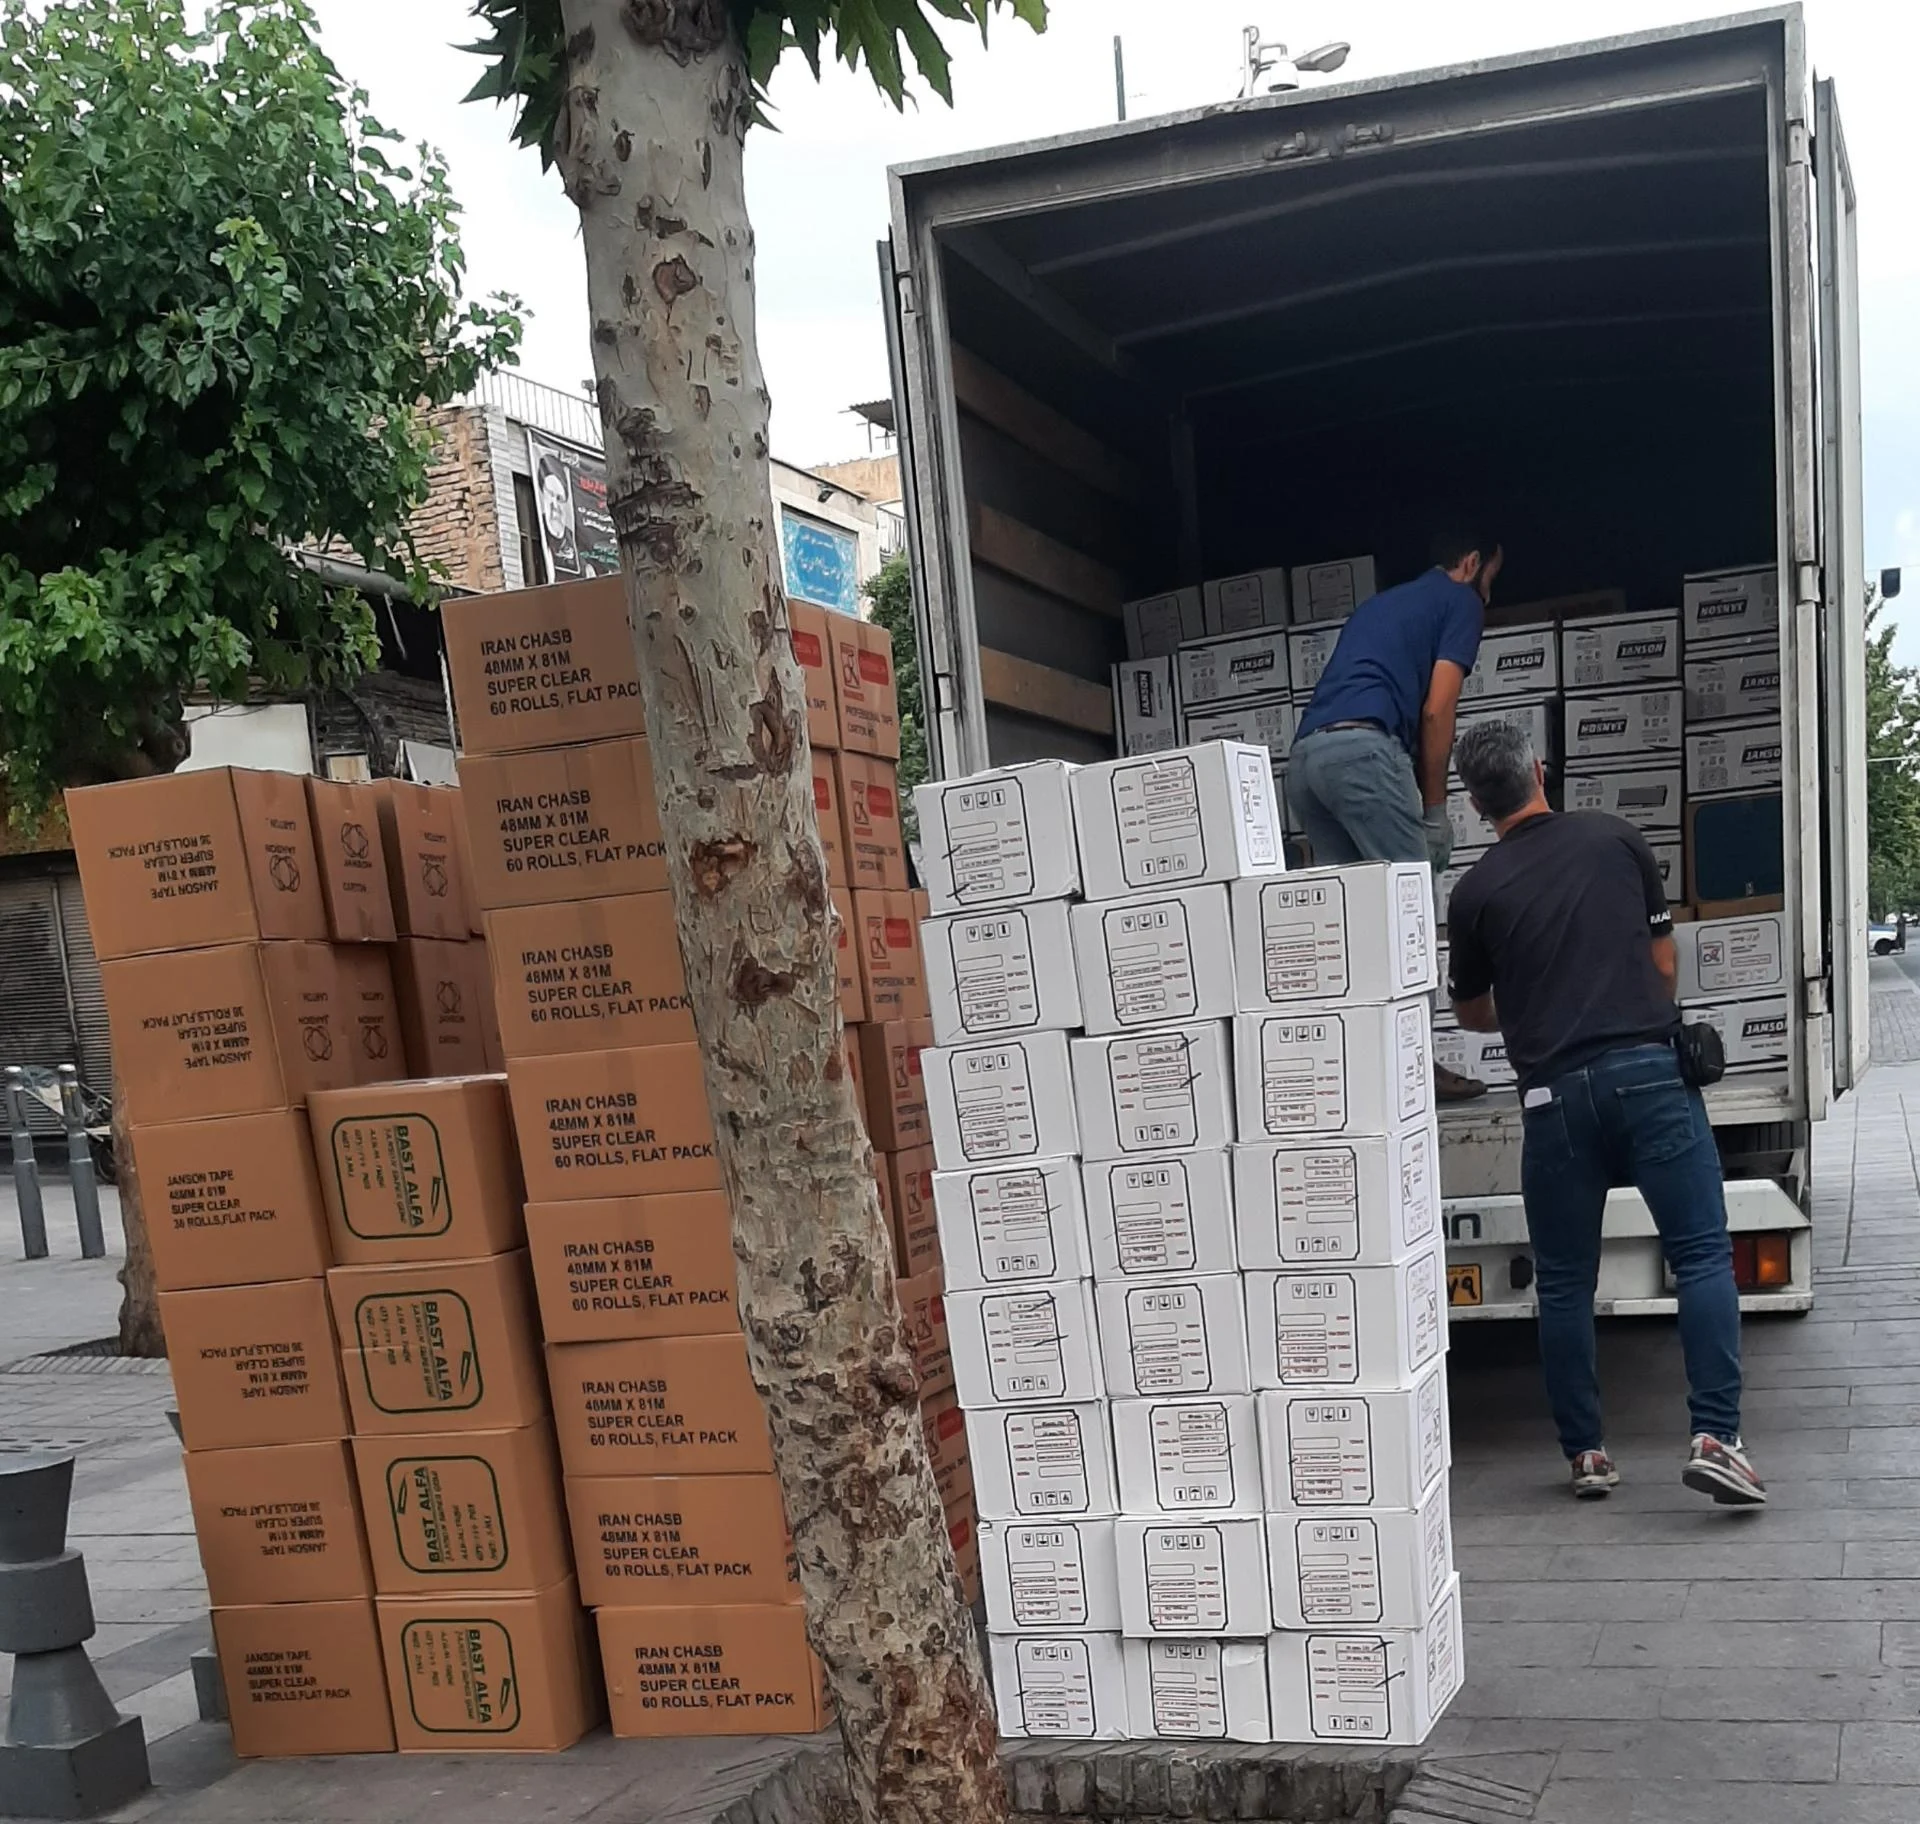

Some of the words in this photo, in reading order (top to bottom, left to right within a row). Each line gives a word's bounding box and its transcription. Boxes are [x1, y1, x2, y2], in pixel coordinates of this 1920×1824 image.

[480, 637, 516, 656] IRAN
[520, 628, 572, 650] CHASB
[527, 654, 538, 670] X
[1499, 653, 1543, 670] JANSON
[487, 676, 538, 696] SUPER
[540, 667, 592, 688] CLEAR
[1743, 674, 1780, 687] JANSO
[490, 701, 507, 716] 60
[567, 686, 602, 705] FLAT
[1746, 747, 1781, 760] JANSO
[497, 796, 533, 814] IRAN
[537, 790, 591, 809] CHASB
[545, 814, 556, 828] X
[503, 834, 555, 853] SUPER
[558, 828, 610, 846] CLEAR
[506, 858, 523, 872] 60
[585, 846, 622, 864] FLAT
[522, 949, 557, 966] IRAN
[561, 944, 613, 962] CHASB
[568, 967, 579, 981] X
[528, 986, 577, 1004] SUPER
[582, 980, 633, 998] CLEAR
[531, 1009, 547, 1023] 60
[608, 999, 644, 1015] FLAT
[649, 992, 692, 1012] PACK
[546, 1098, 581, 1113] IRAN
[585, 1092, 637, 1110] CHASB
[593, 1115, 603, 1128] X
[552, 1134, 602, 1150] SUPER
[605, 1129, 656, 1146] CLEAR
[397, 1125, 416, 1174] BAST
[554, 1155, 571, 1168] 60
[632, 1147, 667, 1162] FLAT
[672, 1144, 713, 1159] PACK
[406, 1181, 424, 1227] ALFA
[563, 1243, 599, 1257] IRAN
[603, 1239, 655, 1255] CHASB
[610, 1260, 619, 1273] X
[569, 1278, 619, 1293] SUPER
[623, 1275, 673, 1290] CLEAR
[572, 1298, 588, 1311] 60
[649, 1292, 684, 1307] FLAT
[689, 1290, 730, 1304] PACK
[425, 1301, 444, 1349] BAST
[435, 1356, 453, 1400] ALFA
[582, 1381, 615, 1394] IRAN
[618, 1380, 667, 1393] CHASB
[626, 1398, 635, 1410] X
[588, 1416, 634, 1429] SUPER
[637, 1414, 684, 1428] CLEAR
[590, 1434, 605, 1446] 60
[662, 1431, 695, 1444] FLAT
[699, 1430, 738, 1444] PACK
[414, 1466, 432, 1511] ALFA
[598, 1514, 631, 1526] IRAN
[634, 1513, 682, 1526] CHASB
[422, 1517, 440, 1563] BAST
[642, 1531, 650, 1542] X
[603, 1548, 649, 1560] SUPER
[653, 1546, 699, 1559] CLEAR
[605, 1564, 621, 1576] 60
[677, 1563, 709, 1576] FLAT
[714, 1563, 752, 1576] PACK
[468, 1629, 486, 1674] BAST
[635, 1647, 669, 1659] IRAN
[673, 1645, 723, 1658] CHASB
[680, 1663, 689, 1674] X
[640, 1679, 687, 1692] SUPER
[692, 1677, 740, 1690] CLEAR
[476, 1680, 492, 1723] ALFA
[642, 1697, 658, 1709] 60
[716, 1693, 751, 1707] FLAT
[755, 1693, 795, 1705] PACK
